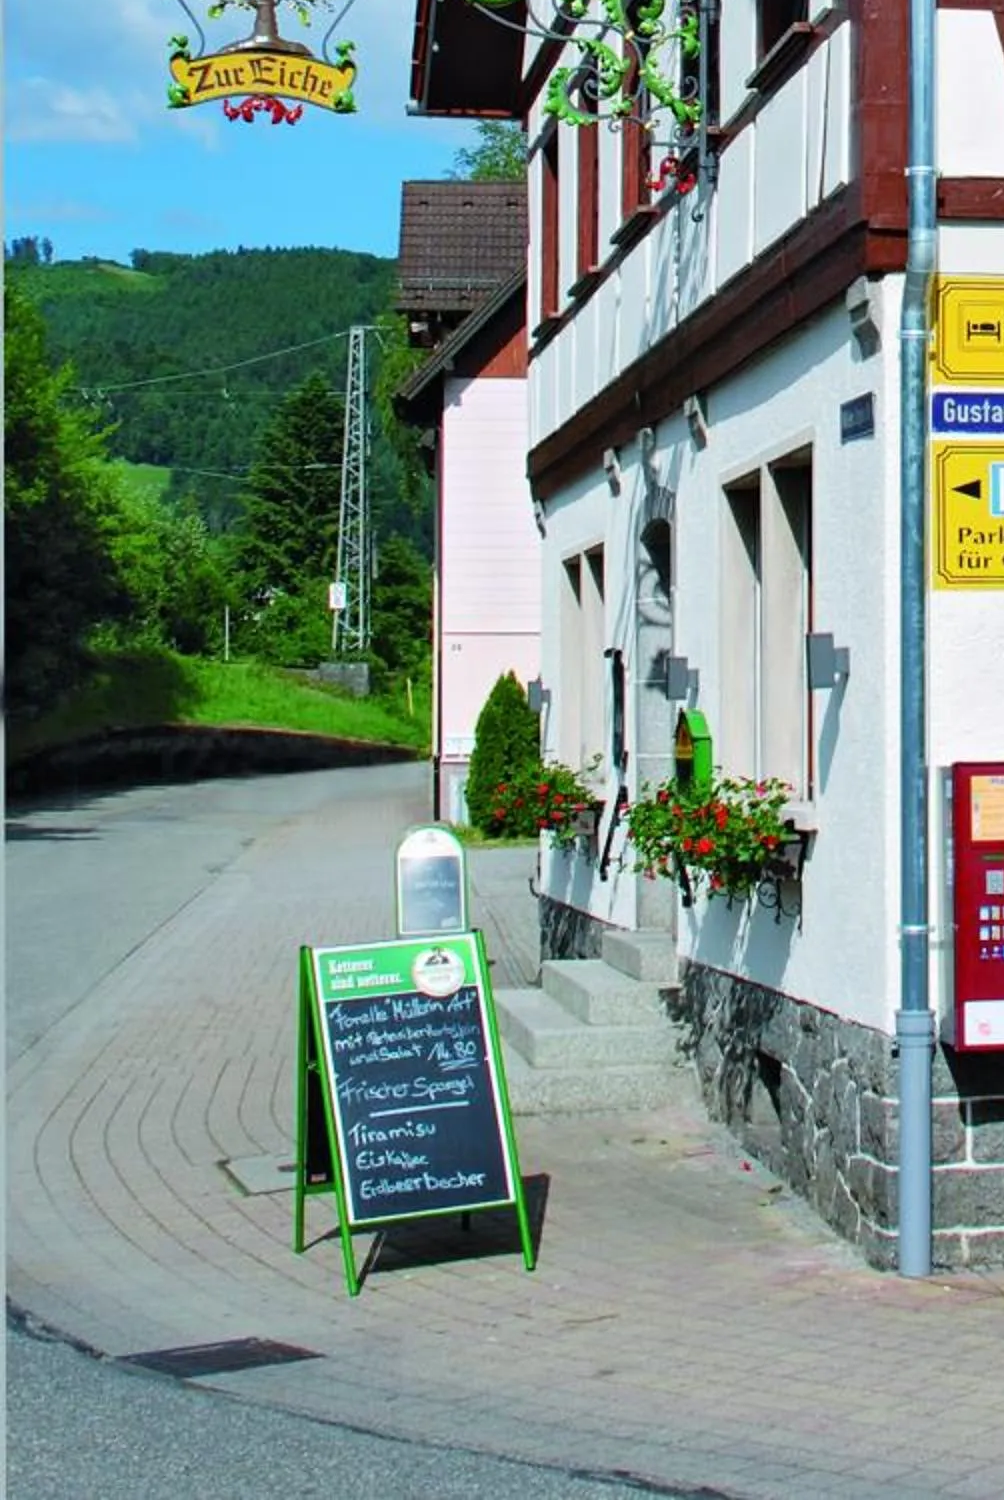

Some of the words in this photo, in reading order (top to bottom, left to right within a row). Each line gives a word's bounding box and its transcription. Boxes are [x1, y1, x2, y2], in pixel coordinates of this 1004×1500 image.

[187, 62, 245, 94] Zur
[247, 56, 334, 98] Eiche
[958, 550, 993, 570] für
[334, 1034, 363, 1052] mit
[348, 1120, 437, 1147] Tiramisu
